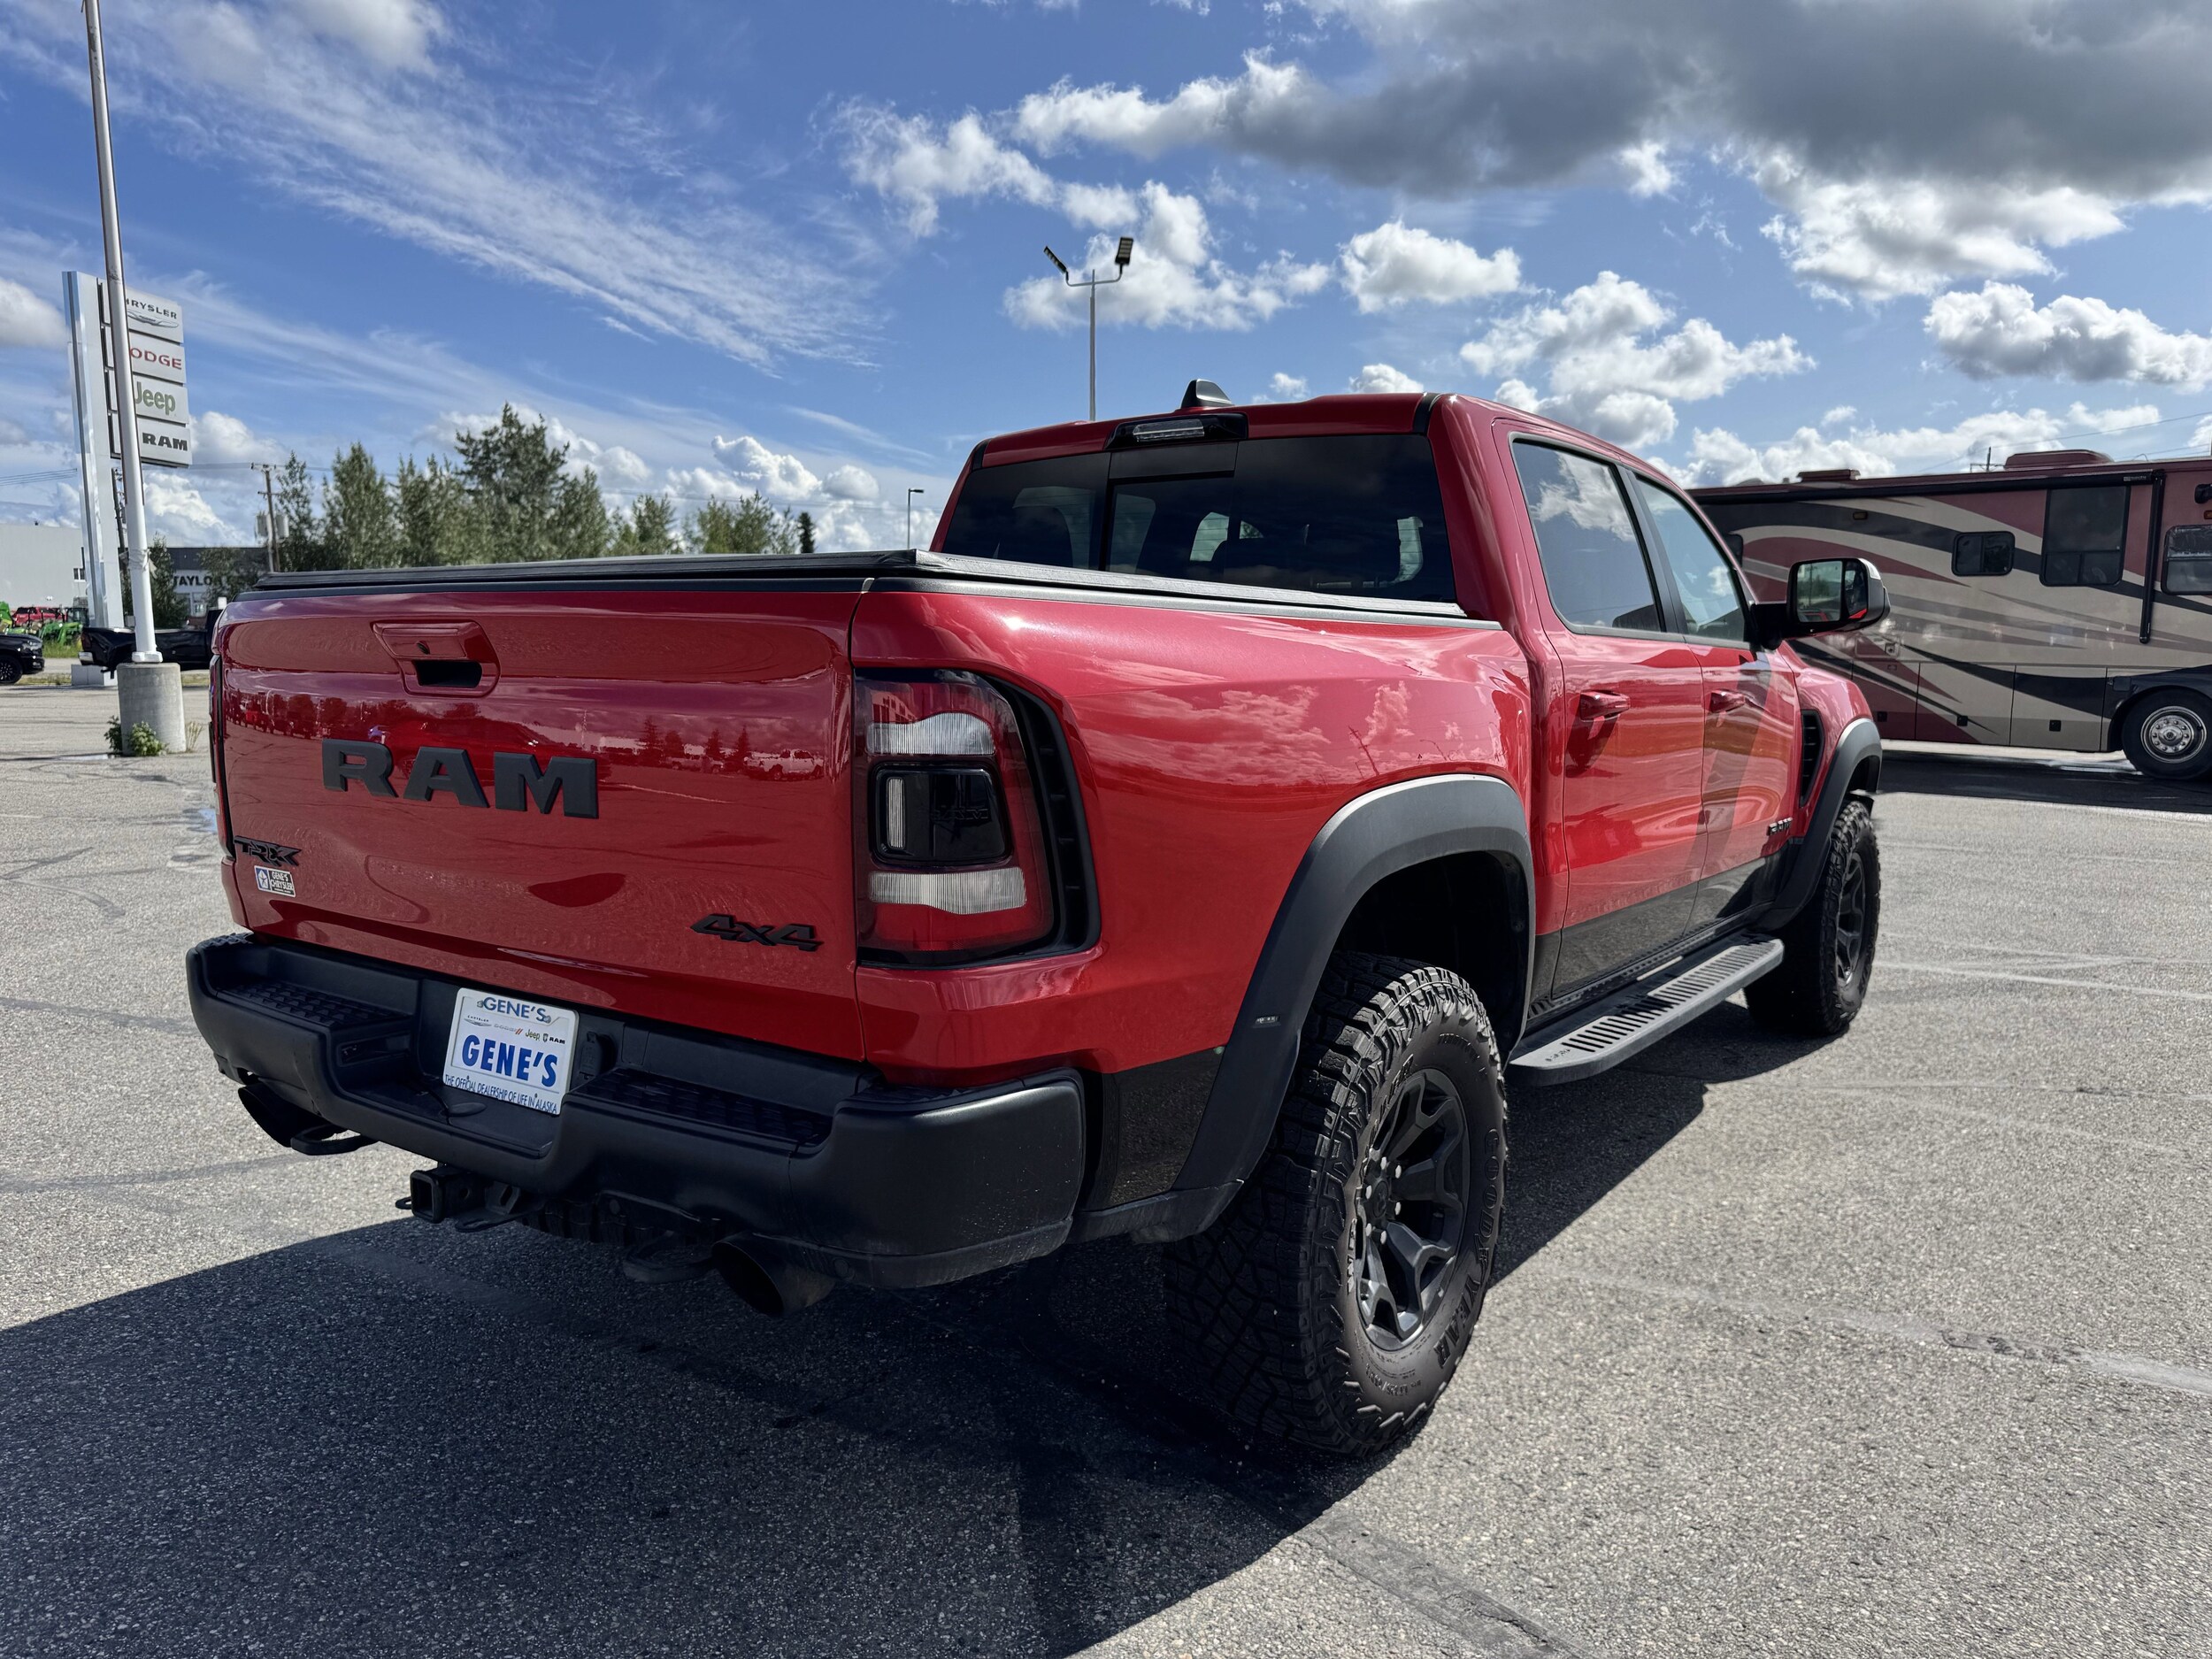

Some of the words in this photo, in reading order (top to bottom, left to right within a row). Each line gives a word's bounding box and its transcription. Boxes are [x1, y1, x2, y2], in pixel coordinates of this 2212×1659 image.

[126, 298, 177, 319] RYSLER
[129, 348, 181, 370] ODGE
[134, 381, 176, 416] Jeep
[142, 432, 188, 450] RAM
[173, 575, 213, 586] TAYLO
[322, 738, 599, 818] RAM
[234, 835, 302, 867] TRX
[483, 996, 547, 1022] GENE'S
[525, 1029, 541, 1041] Jeep
[462, 1034, 558, 1087] GENE'S
[445, 1074, 455, 1087] THE
[478, 1082, 508, 1100] DEALERSHIP
[509, 1091, 517, 1102] OF
[518, 1094, 528, 1106] LIFE
[535, 1099, 557, 1114] ALASKA
